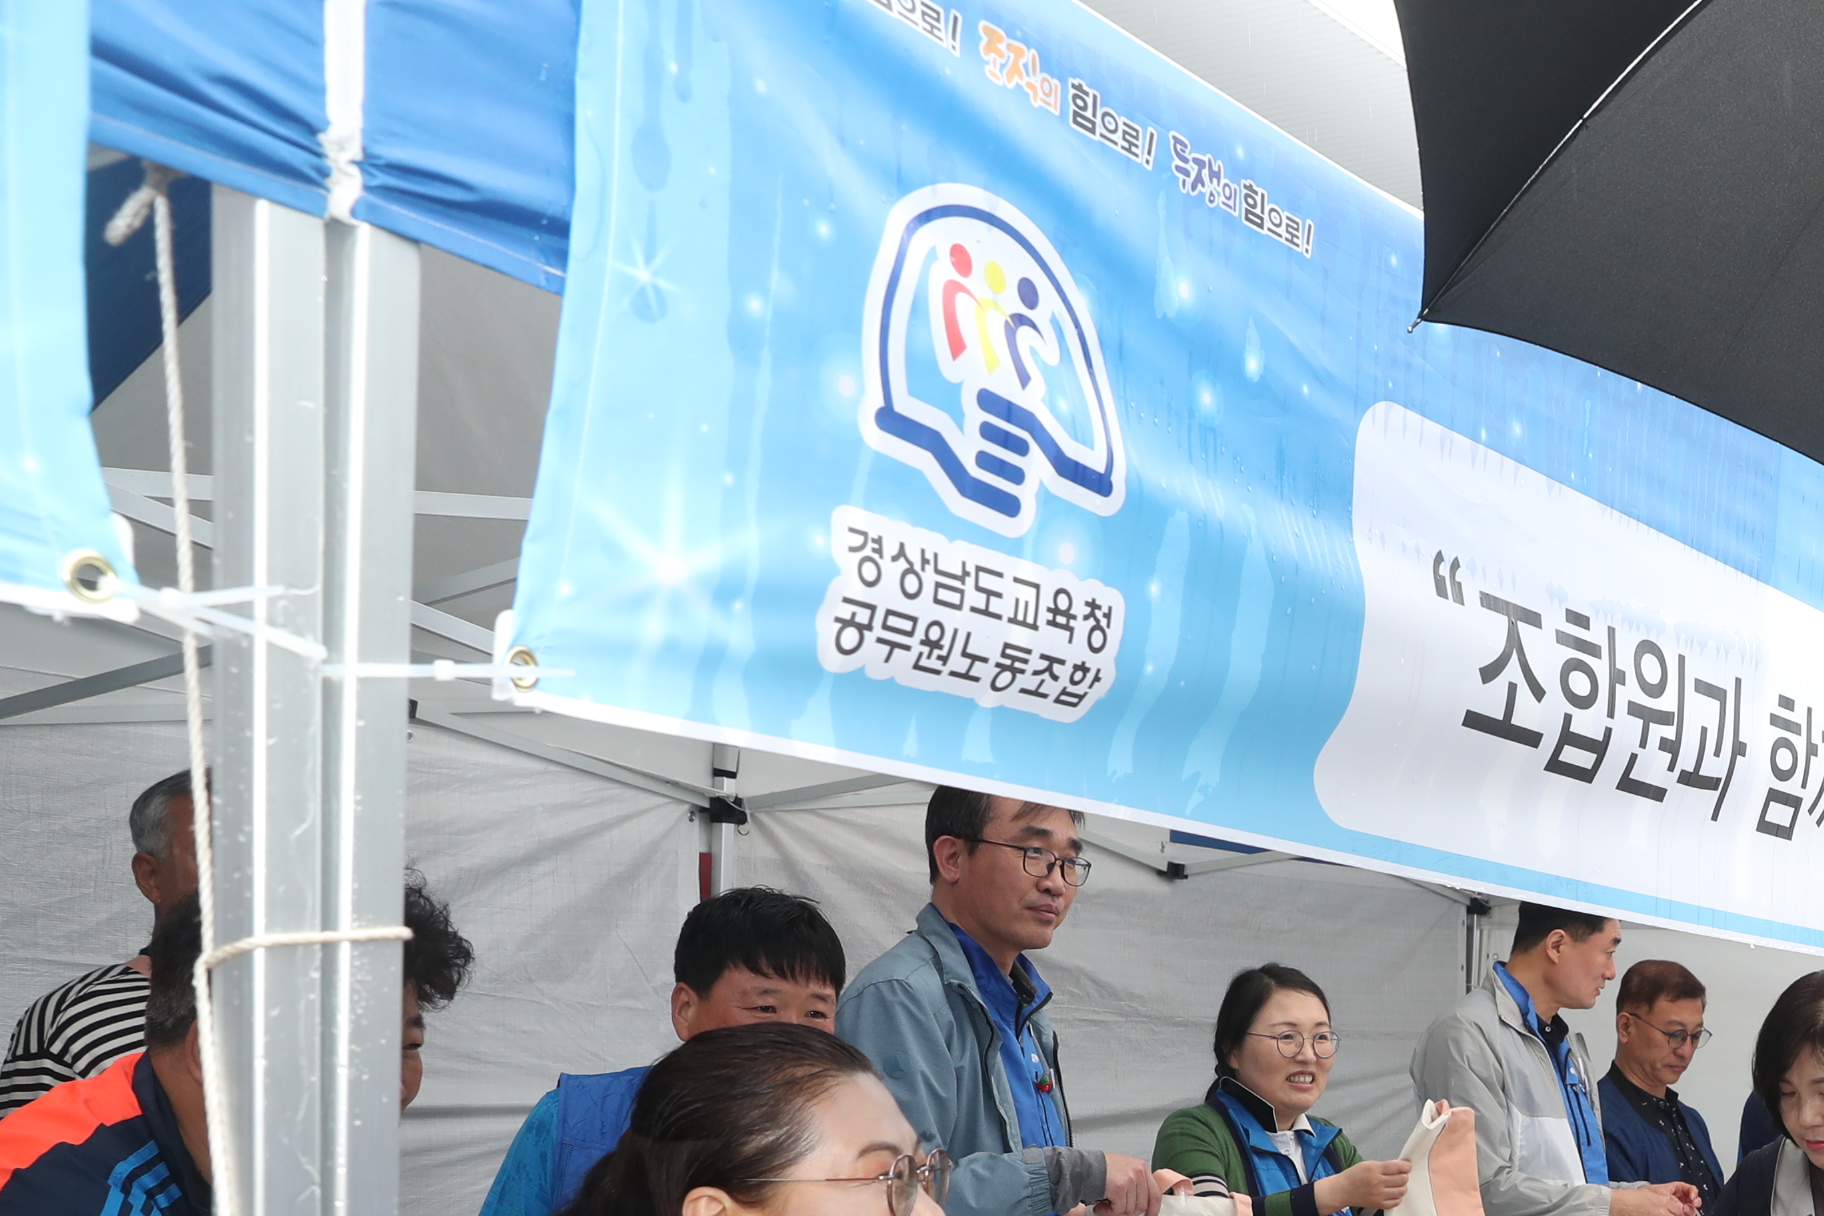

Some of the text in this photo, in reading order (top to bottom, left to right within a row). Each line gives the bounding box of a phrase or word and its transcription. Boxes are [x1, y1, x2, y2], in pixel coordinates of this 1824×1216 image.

[871, 0, 1312, 254] 으로! 조직의 힘으로! 투쟁의 힘으로!
[832, 600, 1102, 709] 공무원노동조합
[847, 527, 1113, 655] 경상남도교육청
